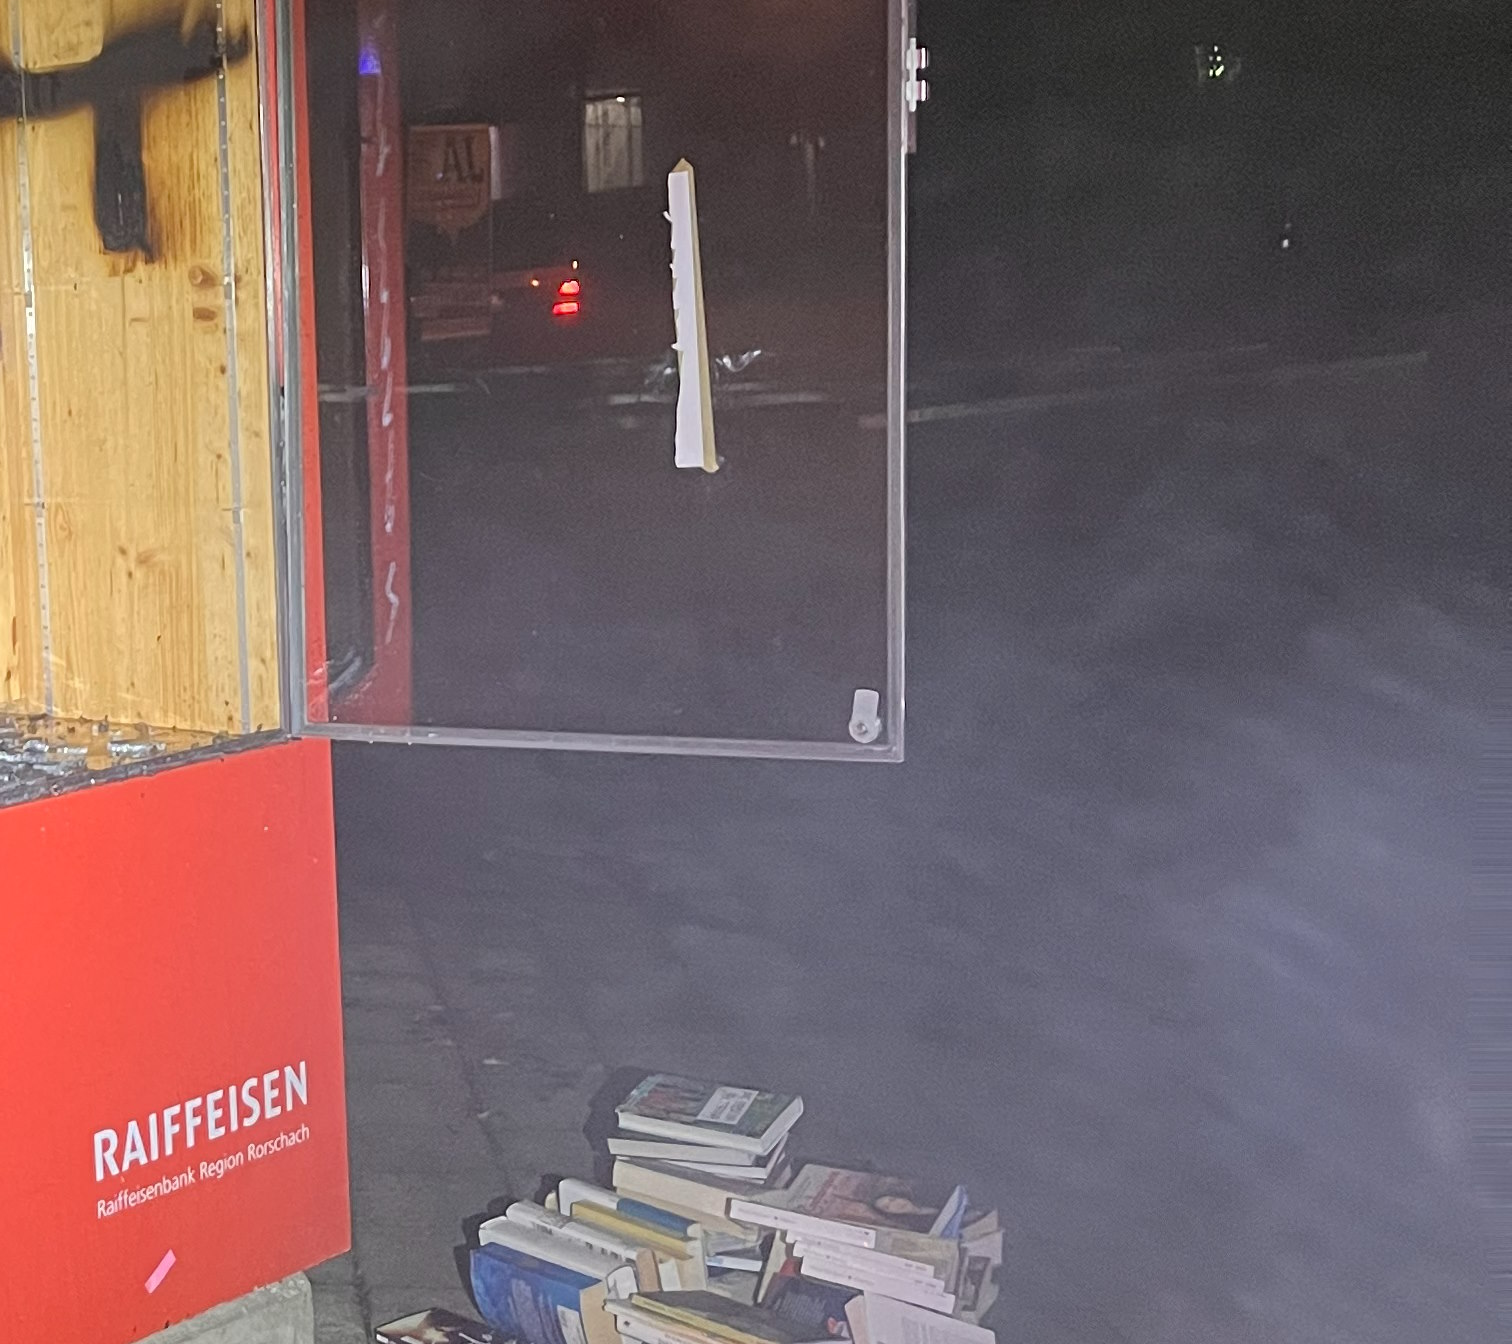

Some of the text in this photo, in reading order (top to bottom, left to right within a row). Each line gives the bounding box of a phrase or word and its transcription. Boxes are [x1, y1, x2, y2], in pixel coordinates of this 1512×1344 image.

[93, 1060, 309, 1182] RAIFFEISEN
[97, 1123, 310, 1219] Raiffeisenbank Region Rorschach
